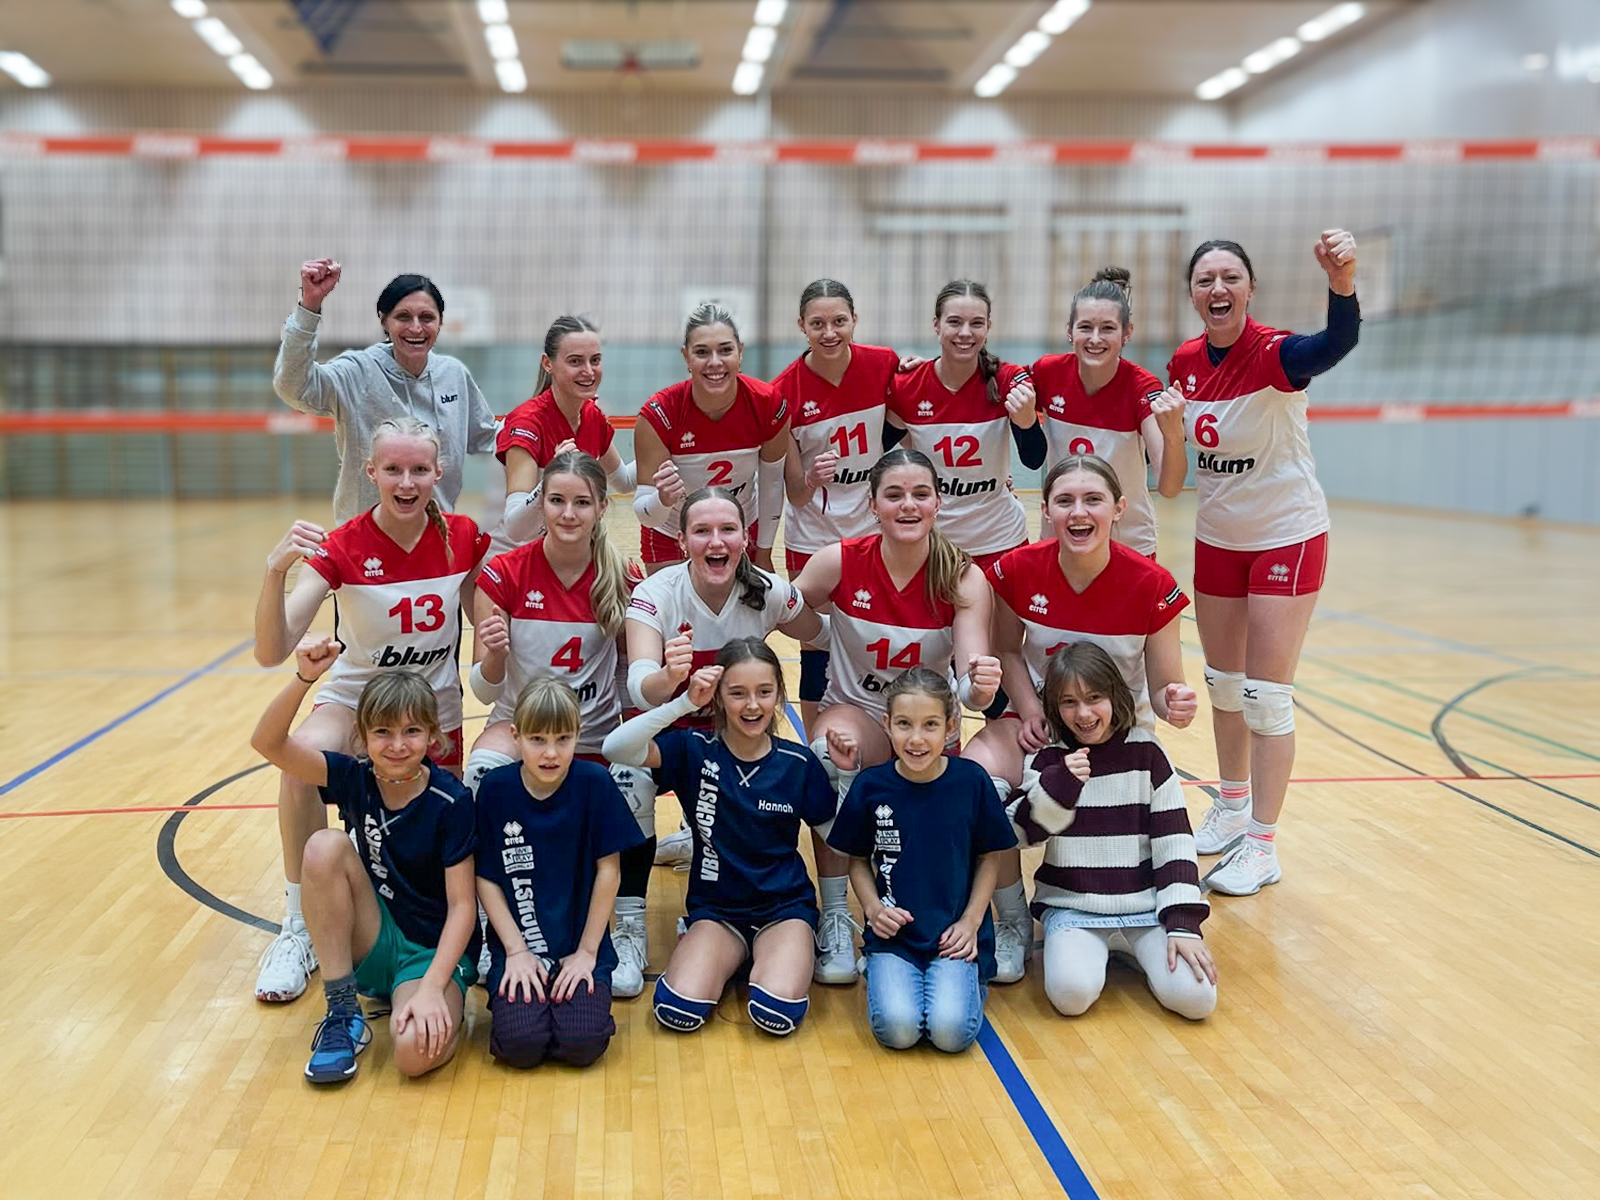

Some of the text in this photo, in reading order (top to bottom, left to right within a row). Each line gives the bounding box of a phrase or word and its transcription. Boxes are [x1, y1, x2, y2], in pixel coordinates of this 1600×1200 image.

[829, 421, 868, 458] 11
[1194, 413, 1220, 448] 6
[933, 435, 983, 468] 12
[706, 460, 734, 486] 2
[1197, 452, 1255, 475] blum
[938, 477, 997, 497] blum
[364, 569, 385, 577] errea
[388, 593, 446, 634] 13
[525, 600, 544, 609] errea
[852, 599, 871, 609] errea
[1028, 604, 1048, 615] errea
[377, 645, 451, 667] blum
[551, 636, 584, 673] 4
[865, 637, 921, 670] 14
[758, 799, 794, 814] Hannah
